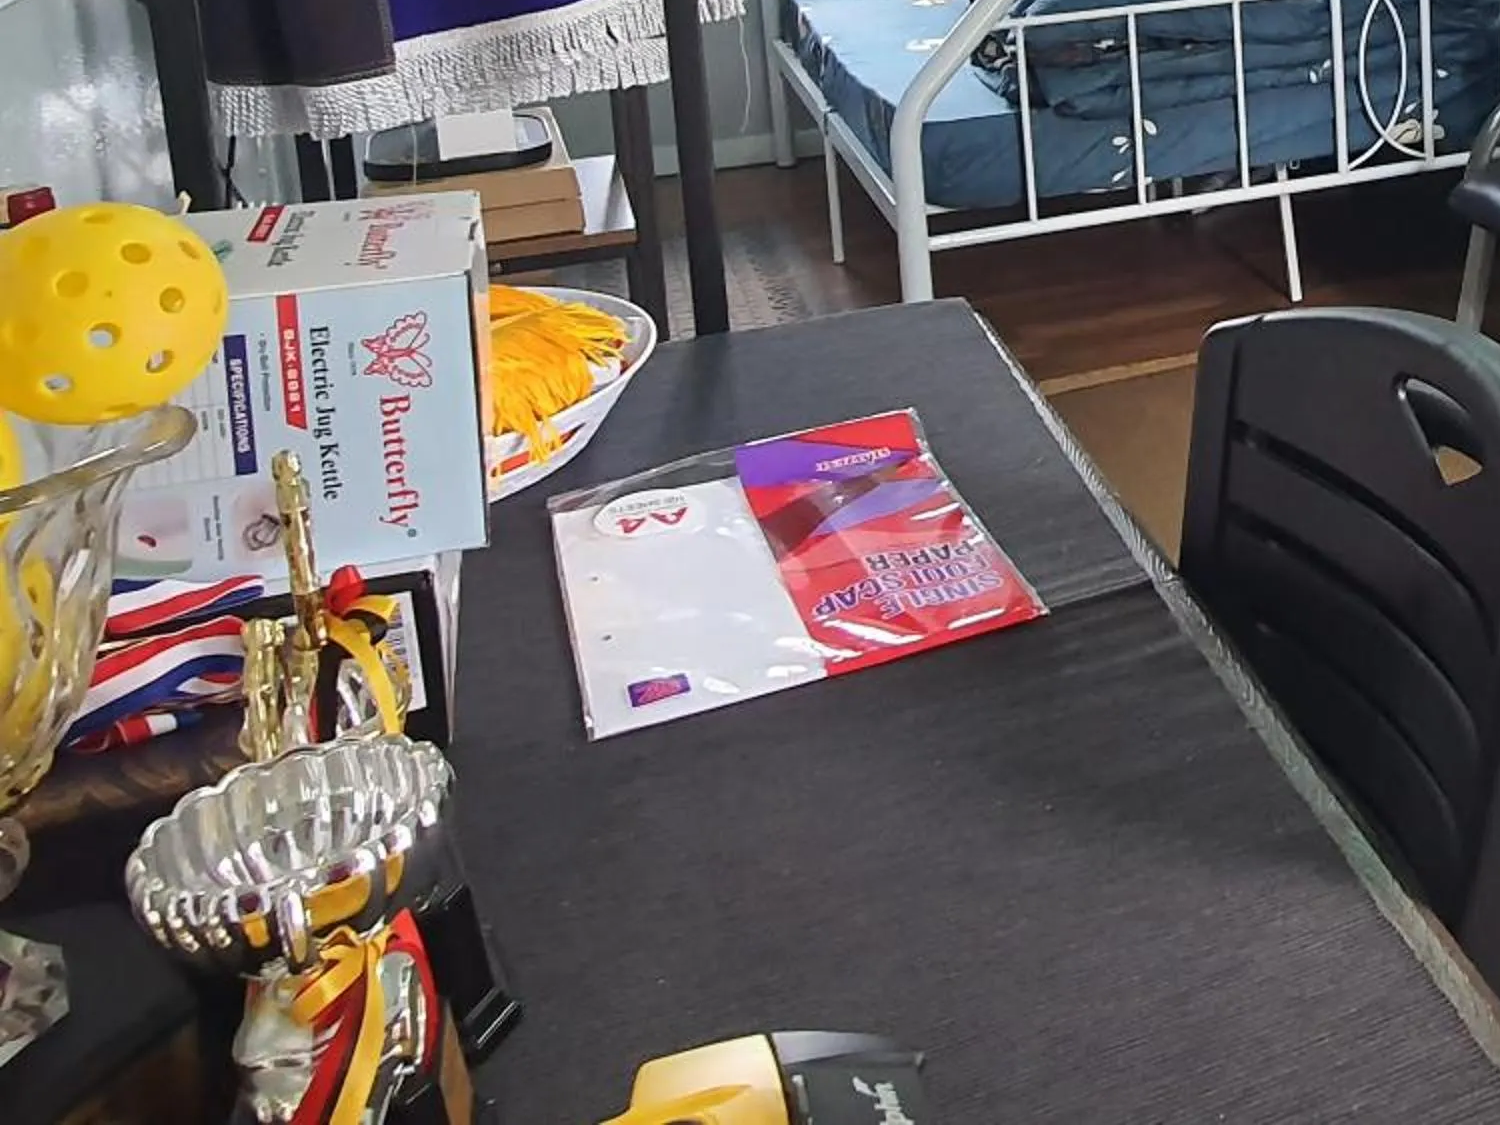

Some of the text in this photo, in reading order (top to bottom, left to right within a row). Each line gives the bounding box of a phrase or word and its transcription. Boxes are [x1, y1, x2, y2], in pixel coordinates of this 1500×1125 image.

[229, 357, 250, 453] SPECIFICATIONS
[309, 325, 342, 501] Electric Jug Kettle
[379, 393, 419, 527] Butterfly
[616, 507, 688, 534] A4
[865, 539, 976, 572] PAPER
[875, 570, 1004, 620] SINGLE
